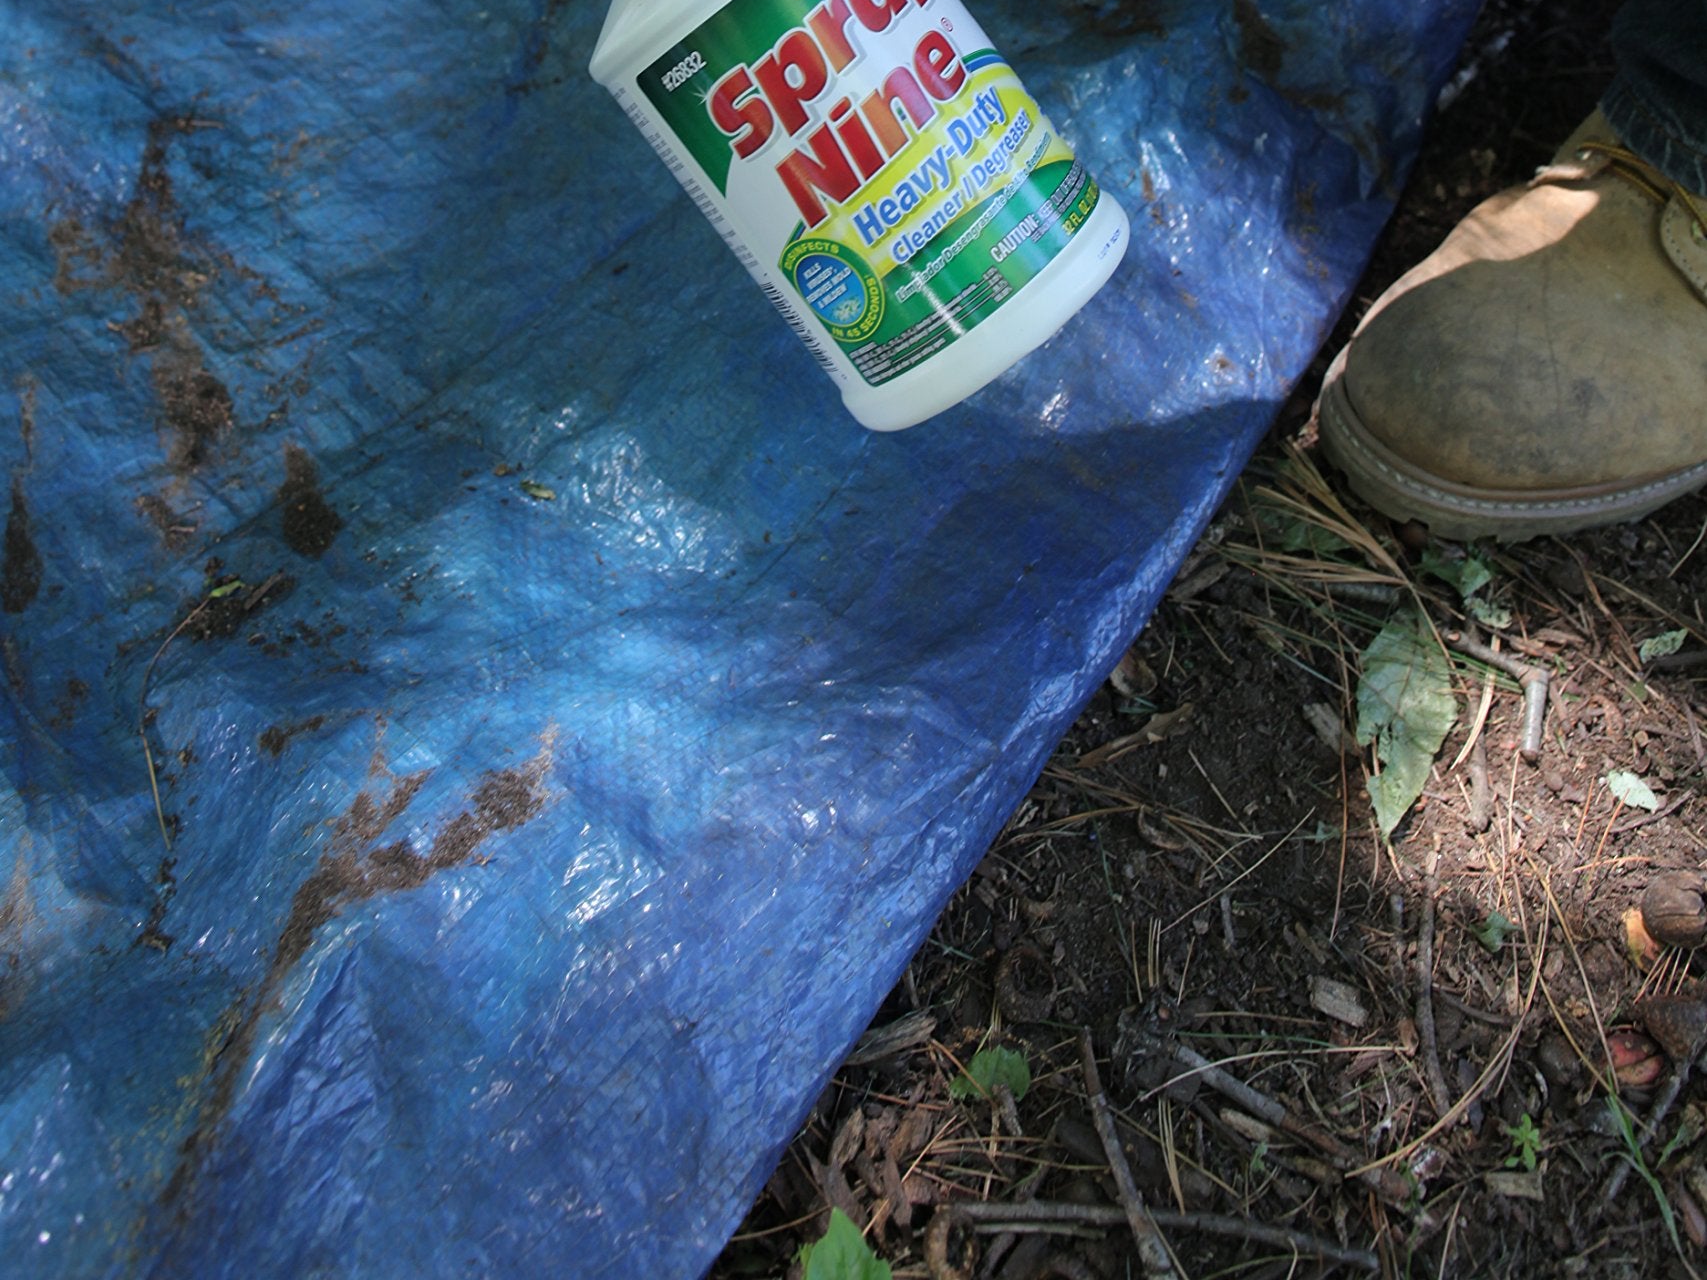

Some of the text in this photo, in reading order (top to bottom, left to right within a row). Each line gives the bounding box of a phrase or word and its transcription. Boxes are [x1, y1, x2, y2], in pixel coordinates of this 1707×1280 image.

[661, 51, 707, 93] #26832
[774, 29, 967, 230] Nine
[852, 85, 1006, 246] Heavy-Duty
[892, 190, 963, 263] Cleaner
[970, 108, 1031, 188] Degreaser
[990, 213, 1040, 262] CAUTION:
